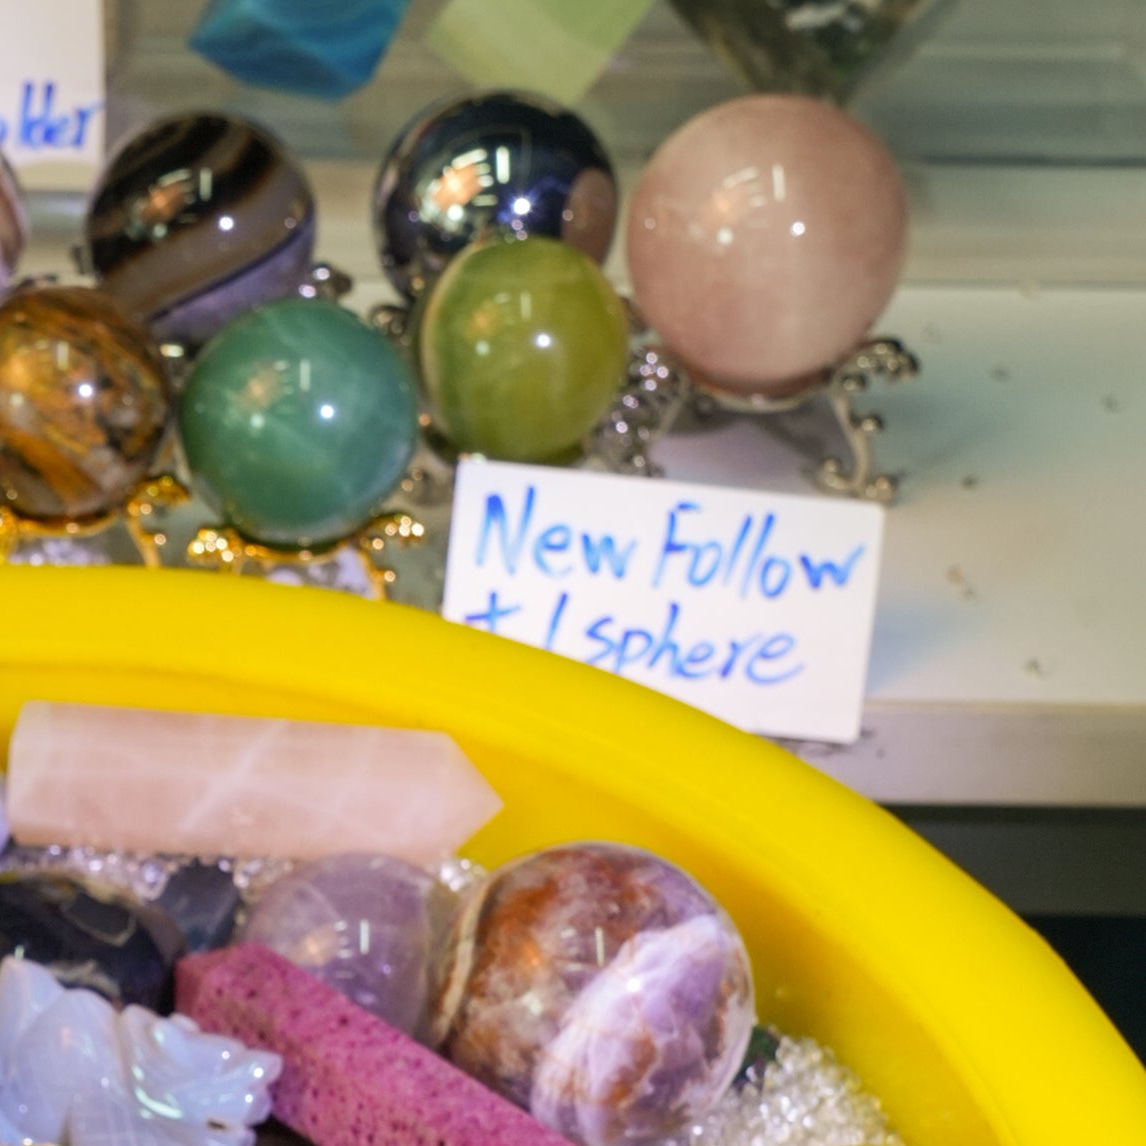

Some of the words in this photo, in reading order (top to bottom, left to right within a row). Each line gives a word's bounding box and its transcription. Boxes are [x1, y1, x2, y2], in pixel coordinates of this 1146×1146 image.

[475, 485, 638, 577] New
[652, 501, 866, 599] Follow
[585, 602, 805, 686] sphere
